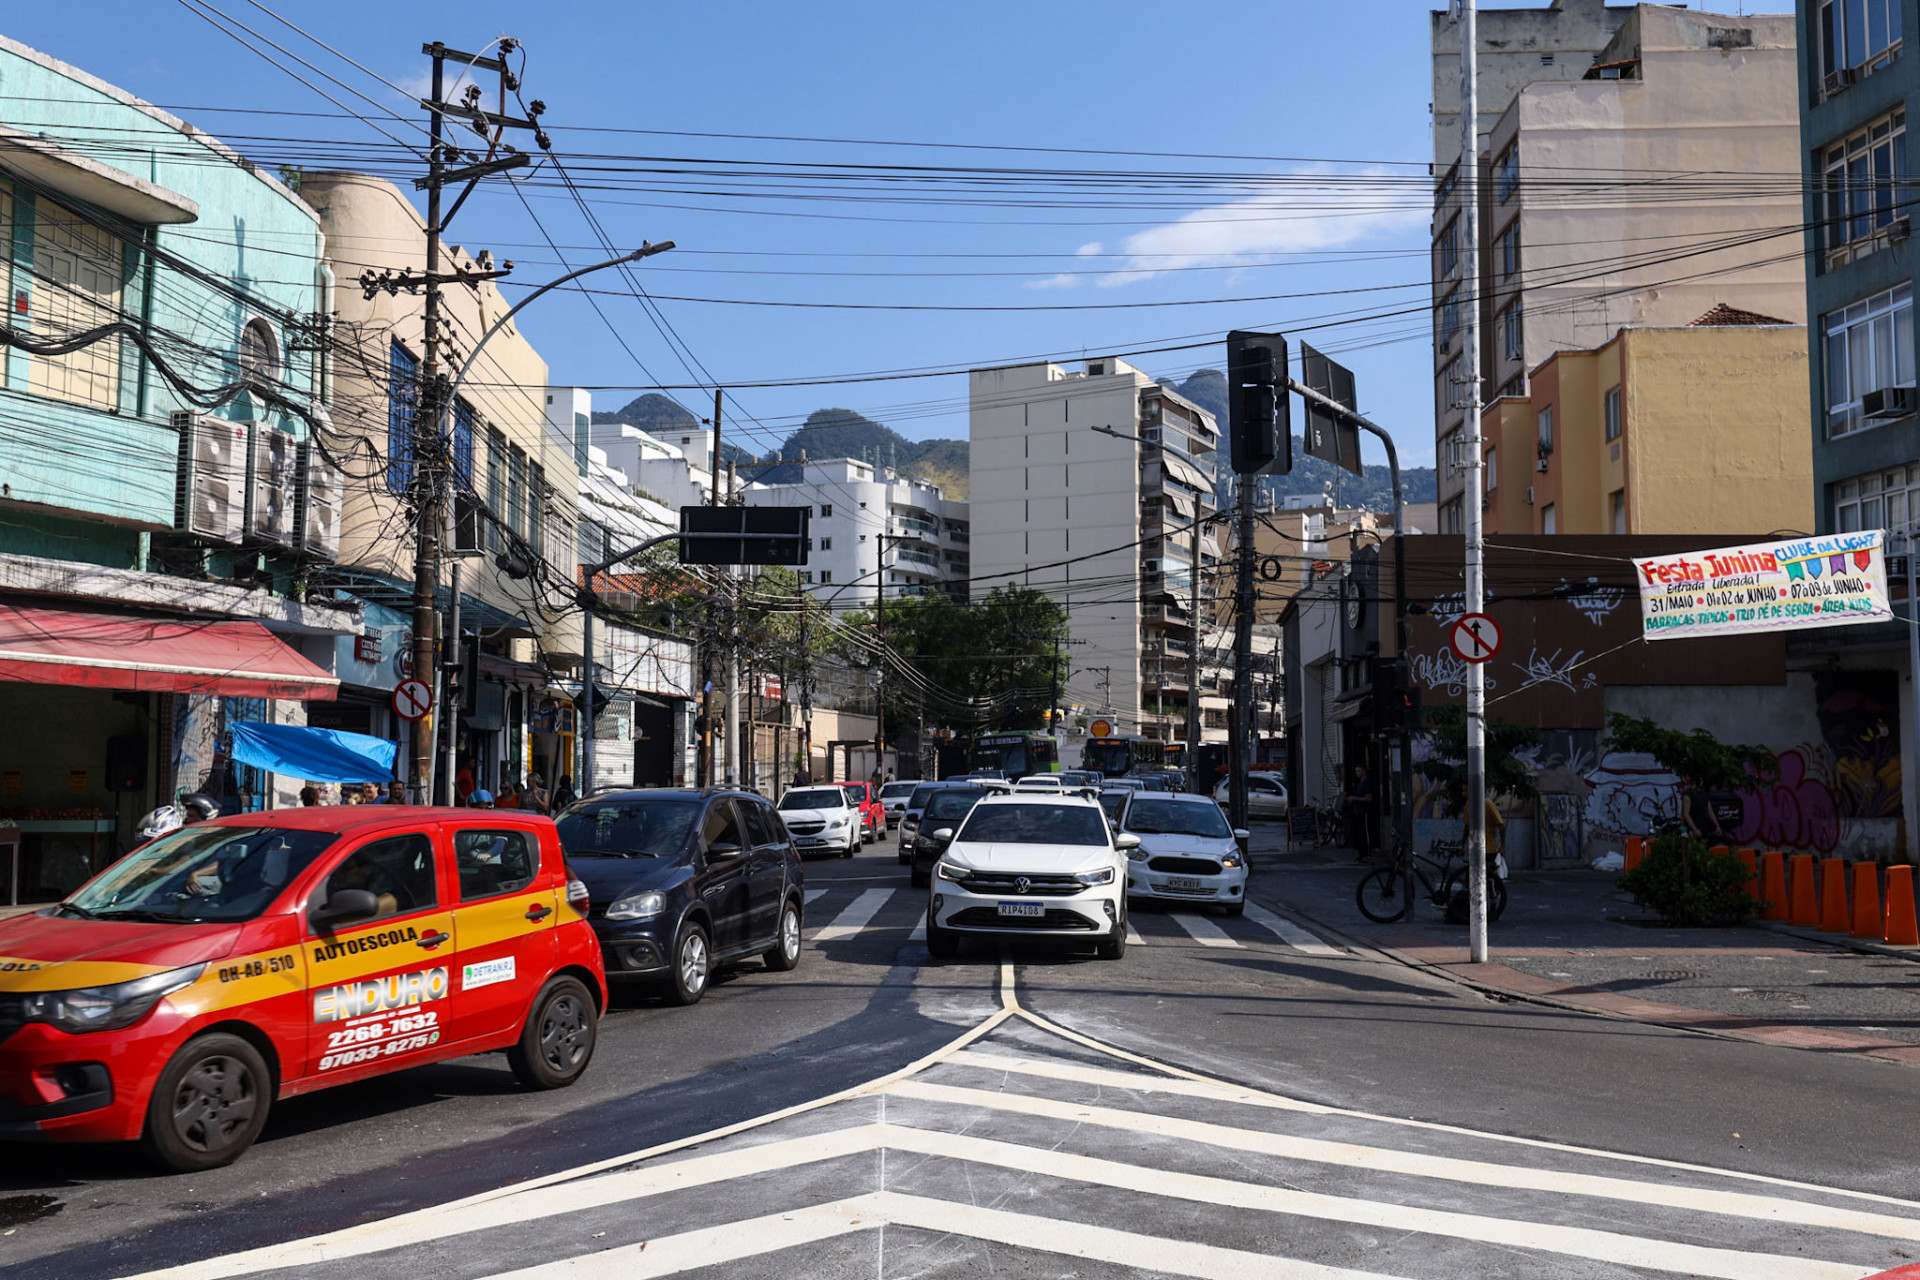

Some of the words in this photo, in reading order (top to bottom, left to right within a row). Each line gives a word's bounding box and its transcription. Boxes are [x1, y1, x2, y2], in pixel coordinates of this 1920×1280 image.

[1774, 541, 1817, 562] CLUBE
[1817, 542, 1836, 553] DA
[1834, 533, 1876, 551] LIGHT
[1640, 557, 1704, 585] Festa
[1703, 550, 1778, 578] Junina
[1651, 594, 1694, 613] 31/MAIO
[1747, 586, 1777, 606] JUNHO
[1833, 577, 1865, 595] JUNHO
[1645, 613, 1695, 630] BARRACAS
[1736, 608, 1755, 622] TRIO
[1758, 603, 1770, 619] PÉ
[1771, 606, 1782, 618] DE
[1785, 603, 1814, 618] SERRA
[1821, 598, 1845, 613] ÁREA
[1847, 597, 1873, 611] KIDS
[314, 926, 418, 963] AUTOESCOLA
[313, 966, 448, 1024] ENDURO
[327, 1011, 438, 1049] 2268-7632
[318, 1033, 430, 1071] 97033-8275
